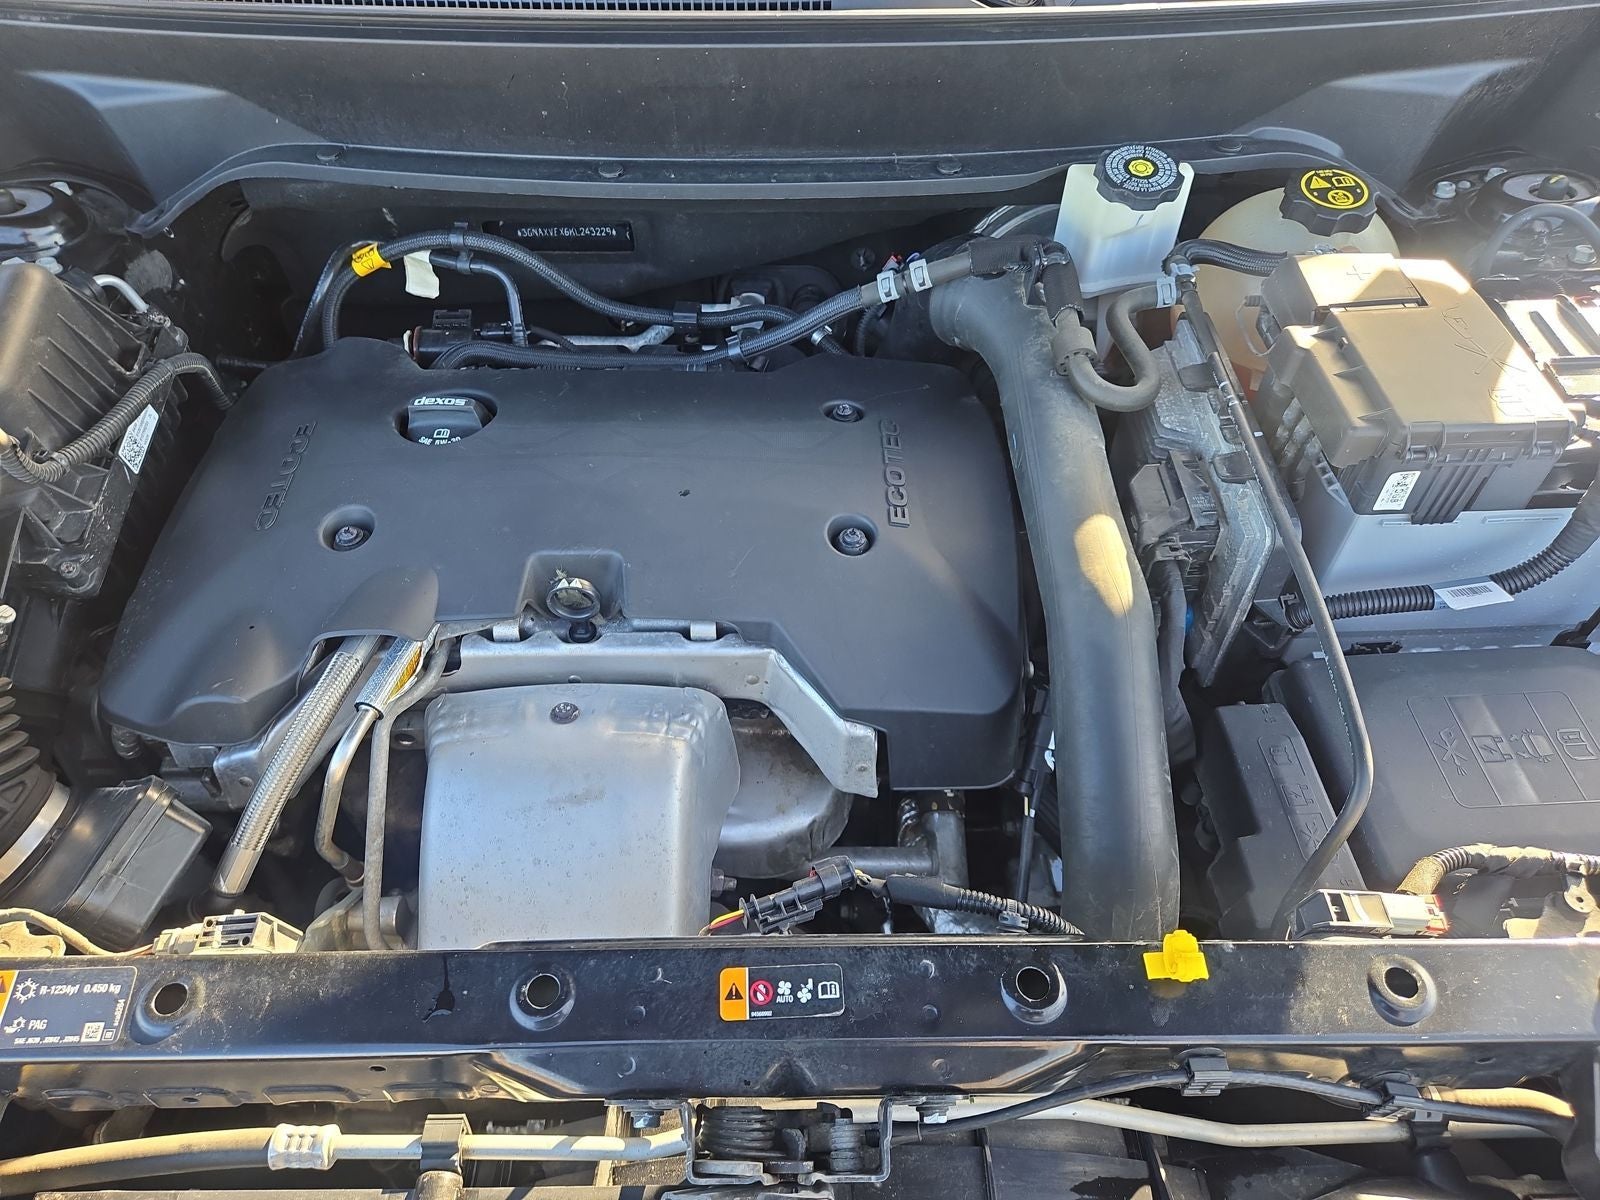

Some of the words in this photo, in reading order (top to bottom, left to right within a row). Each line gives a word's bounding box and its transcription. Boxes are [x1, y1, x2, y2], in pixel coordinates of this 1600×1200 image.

[413, 396, 467, 406] dexos
[418, 436, 433, 446] SAE
[879, 418, 910, 528] ECOTEC
[39, 984, 80, 996] R-1234yf
[83, 984, 109, 994] 0.450
[109, 983, 121, 995] kg
[776, 995, 794, 1004] AUTO
[28, 1019, 48, 1031] PAG
